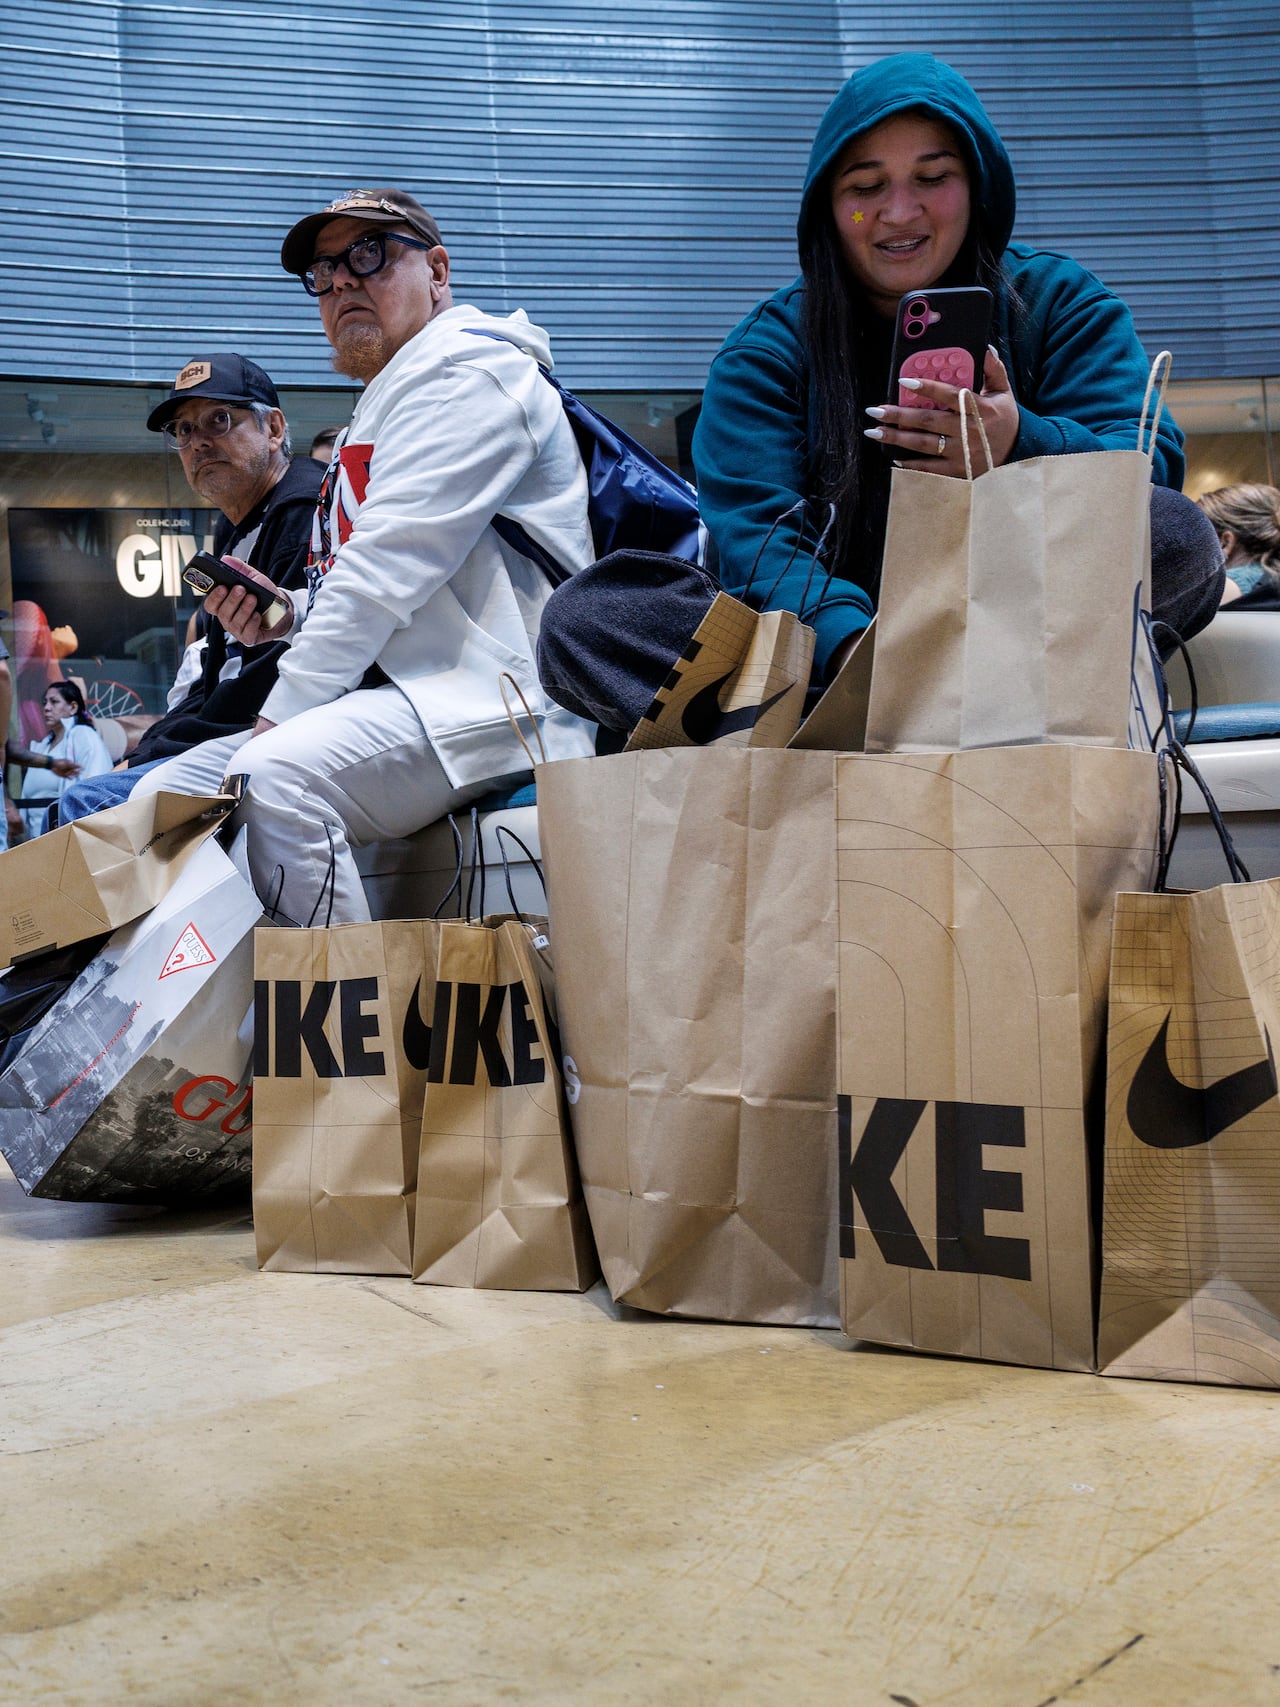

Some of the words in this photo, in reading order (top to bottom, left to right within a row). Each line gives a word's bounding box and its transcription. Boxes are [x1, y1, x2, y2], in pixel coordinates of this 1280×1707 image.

[136, 519, 158, 527] COLE
[183, 932, 207, 962] GUESS
[173, 1075, 253, 1135] GU
[176, 1143, 211, 1161] LOS
[837, 1094, 1032, 1281] KE
